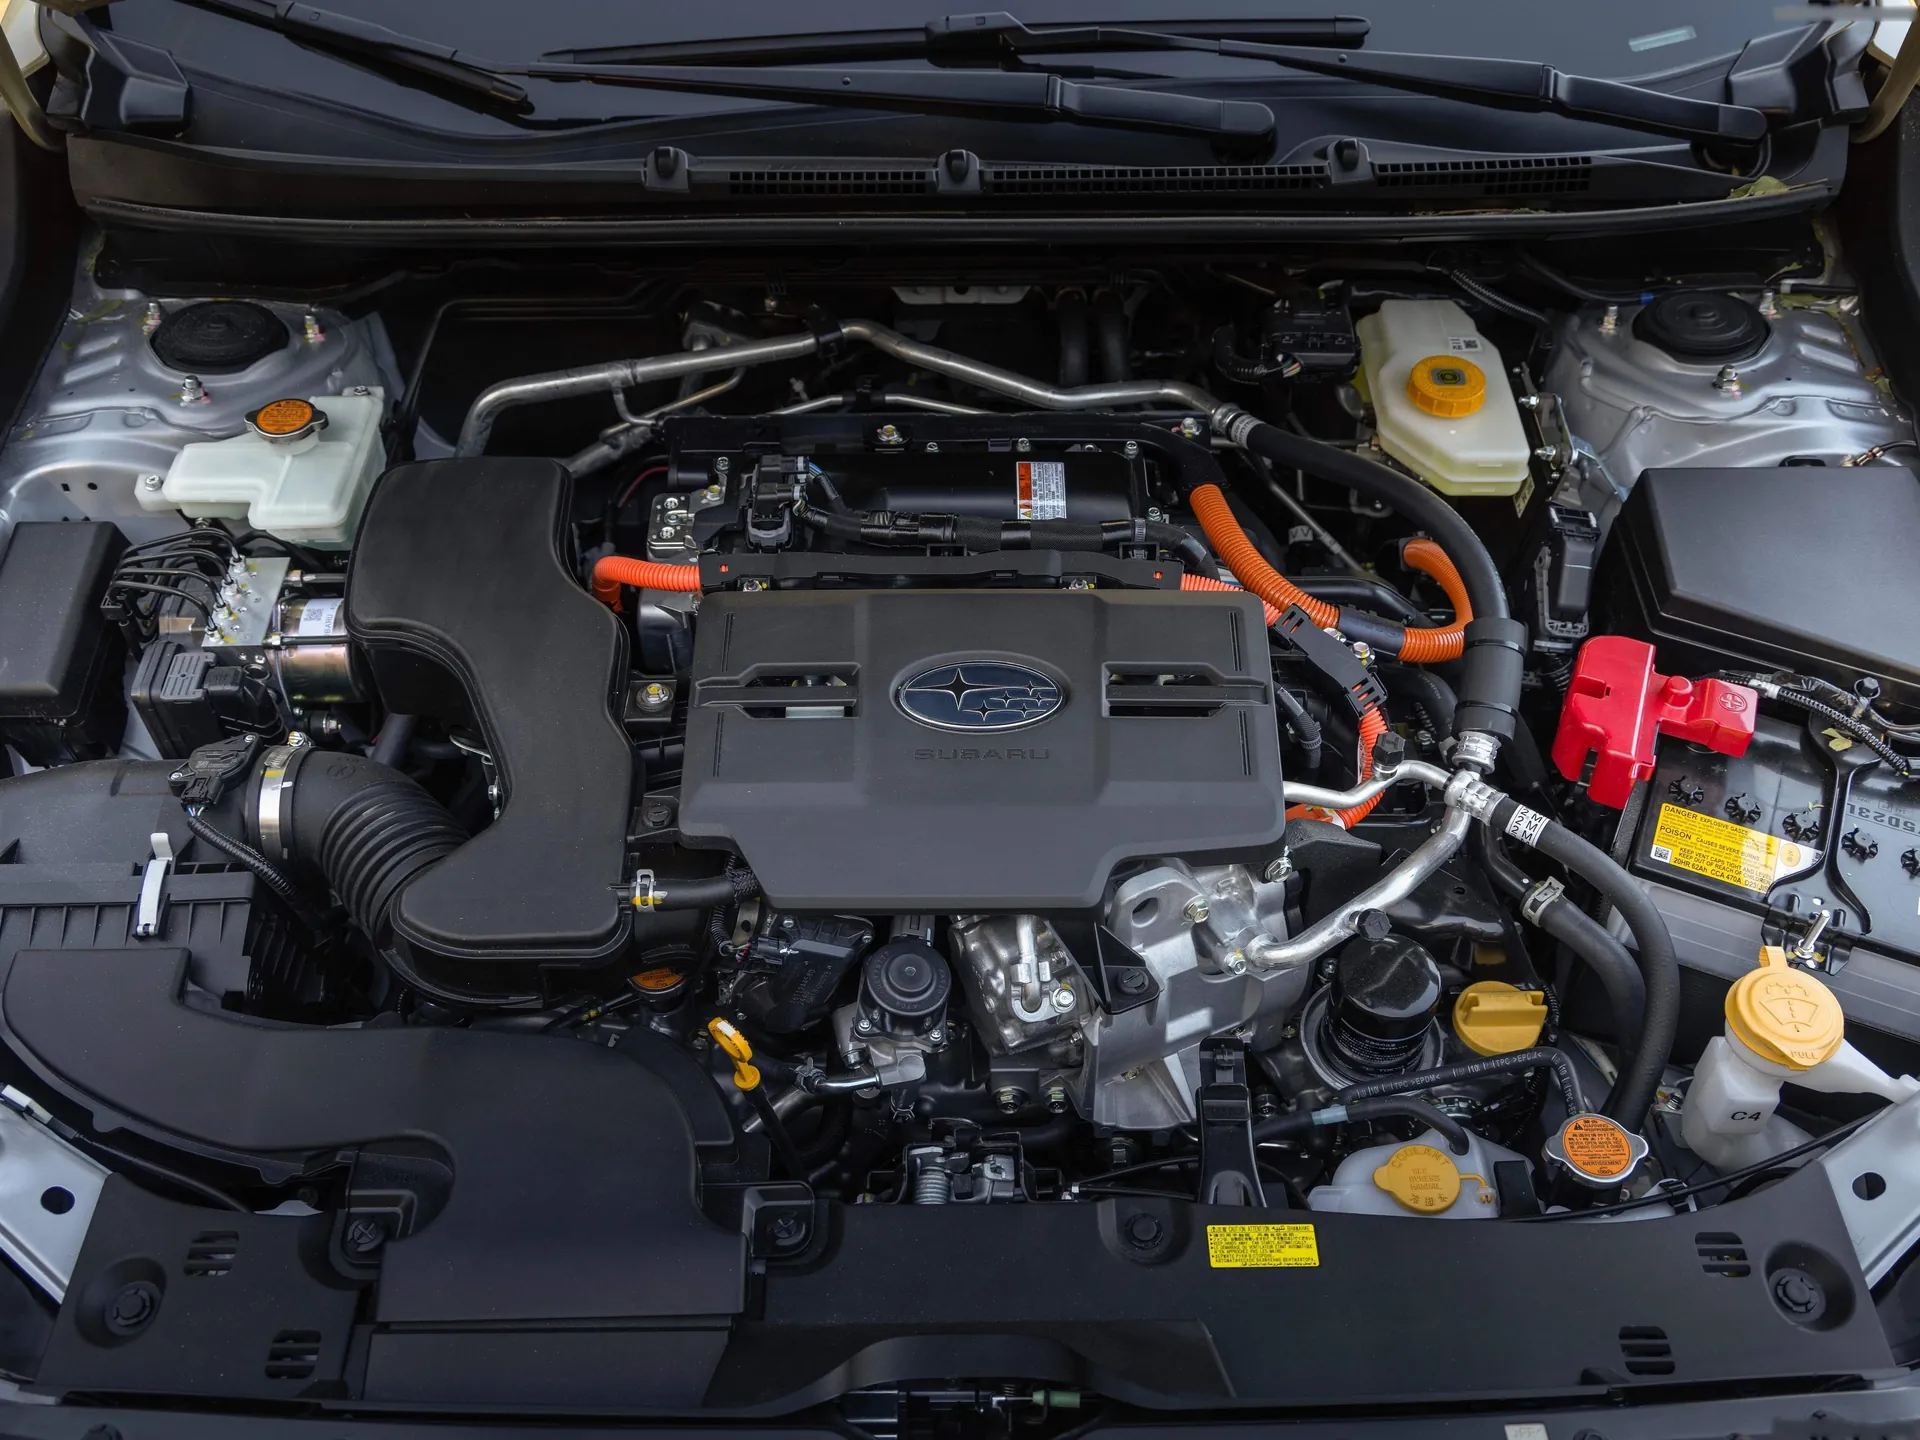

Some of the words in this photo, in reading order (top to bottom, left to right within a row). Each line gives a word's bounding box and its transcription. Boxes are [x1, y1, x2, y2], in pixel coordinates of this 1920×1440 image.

[324, 614, 334, 637] BARU
[914, 748, 1050, 760] SUBARU
[1515, 816, 1524, 825] 2
[1526, 821, 1538, 832] M
[1531, 813, 1542, 823] M
[1664, 805, 1698, 820] DANGER
[1700, 816, 1729, 830] EXPLOSIVE
[1730, 826, 1748, 836] GASES
[1846, 803, 1920, 834] 5D23L
[1511, 825, 1519, 834] 2
[1522, 830, 1533, 841] M
[1659, 825, 1692, 840] POISON
[1696, 837, 1718, 848] CAUSES
[1719, 844, 1740, 854] SEVERE
[1741, 850, 1760, 860] BURNS
[1679, 852, 1694, 860] KEEP
[1715, 863, 1734, 873] REACH
[1680, 847, 1694, 856] KEEP
[1695, 852, 1709, 860] VENT
[1710, 856, 1725, 865] CAPS
[1726, 861, 1742, 870] TIGHT
[1673, 857, 1691, 868] 20HR
[1691, 862, 1708, 873] 62Ah
[1710, 869, 1725, 879] CCA
[1725, 874, 1742, 884] 470A
[1790, 1050, 1818, 1060] PULL
[1730, 1111, 1761, 1122] C4
[1392, 1146, 1451, 1168] COOLANT
[1410, 1183, 1442, 1191] MANUAL
